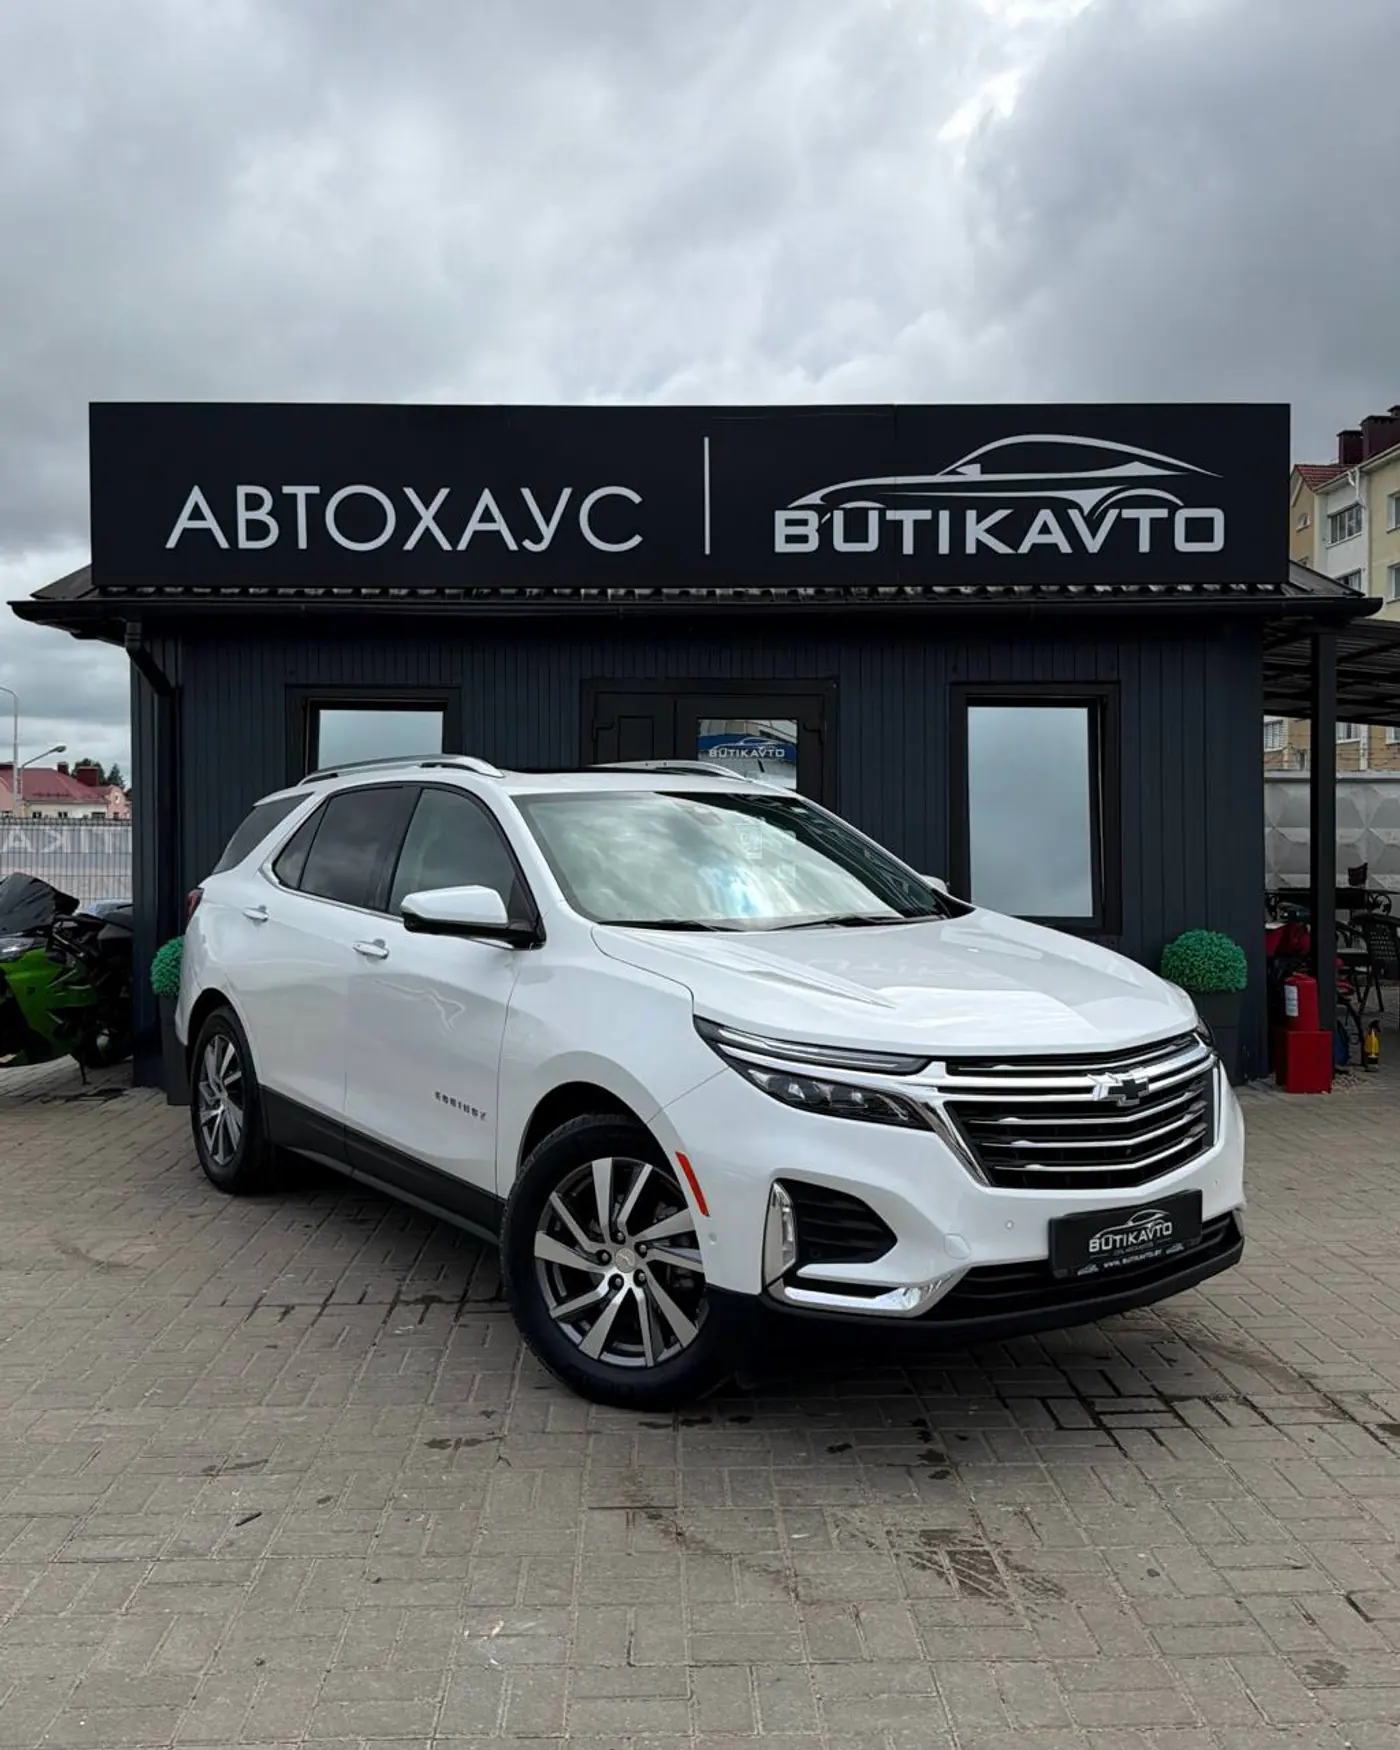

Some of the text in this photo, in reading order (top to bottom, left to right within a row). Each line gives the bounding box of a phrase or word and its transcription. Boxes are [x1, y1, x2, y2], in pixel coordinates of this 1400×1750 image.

[165, 484, 645, 553] АВТОХАУС
[774, 507, 1226, 555] BUTIKAVTO
[708, 748, 785, 758] BUTIKAVTO
[1088, 1222, 1173, 1253] BUTIKAVTO
